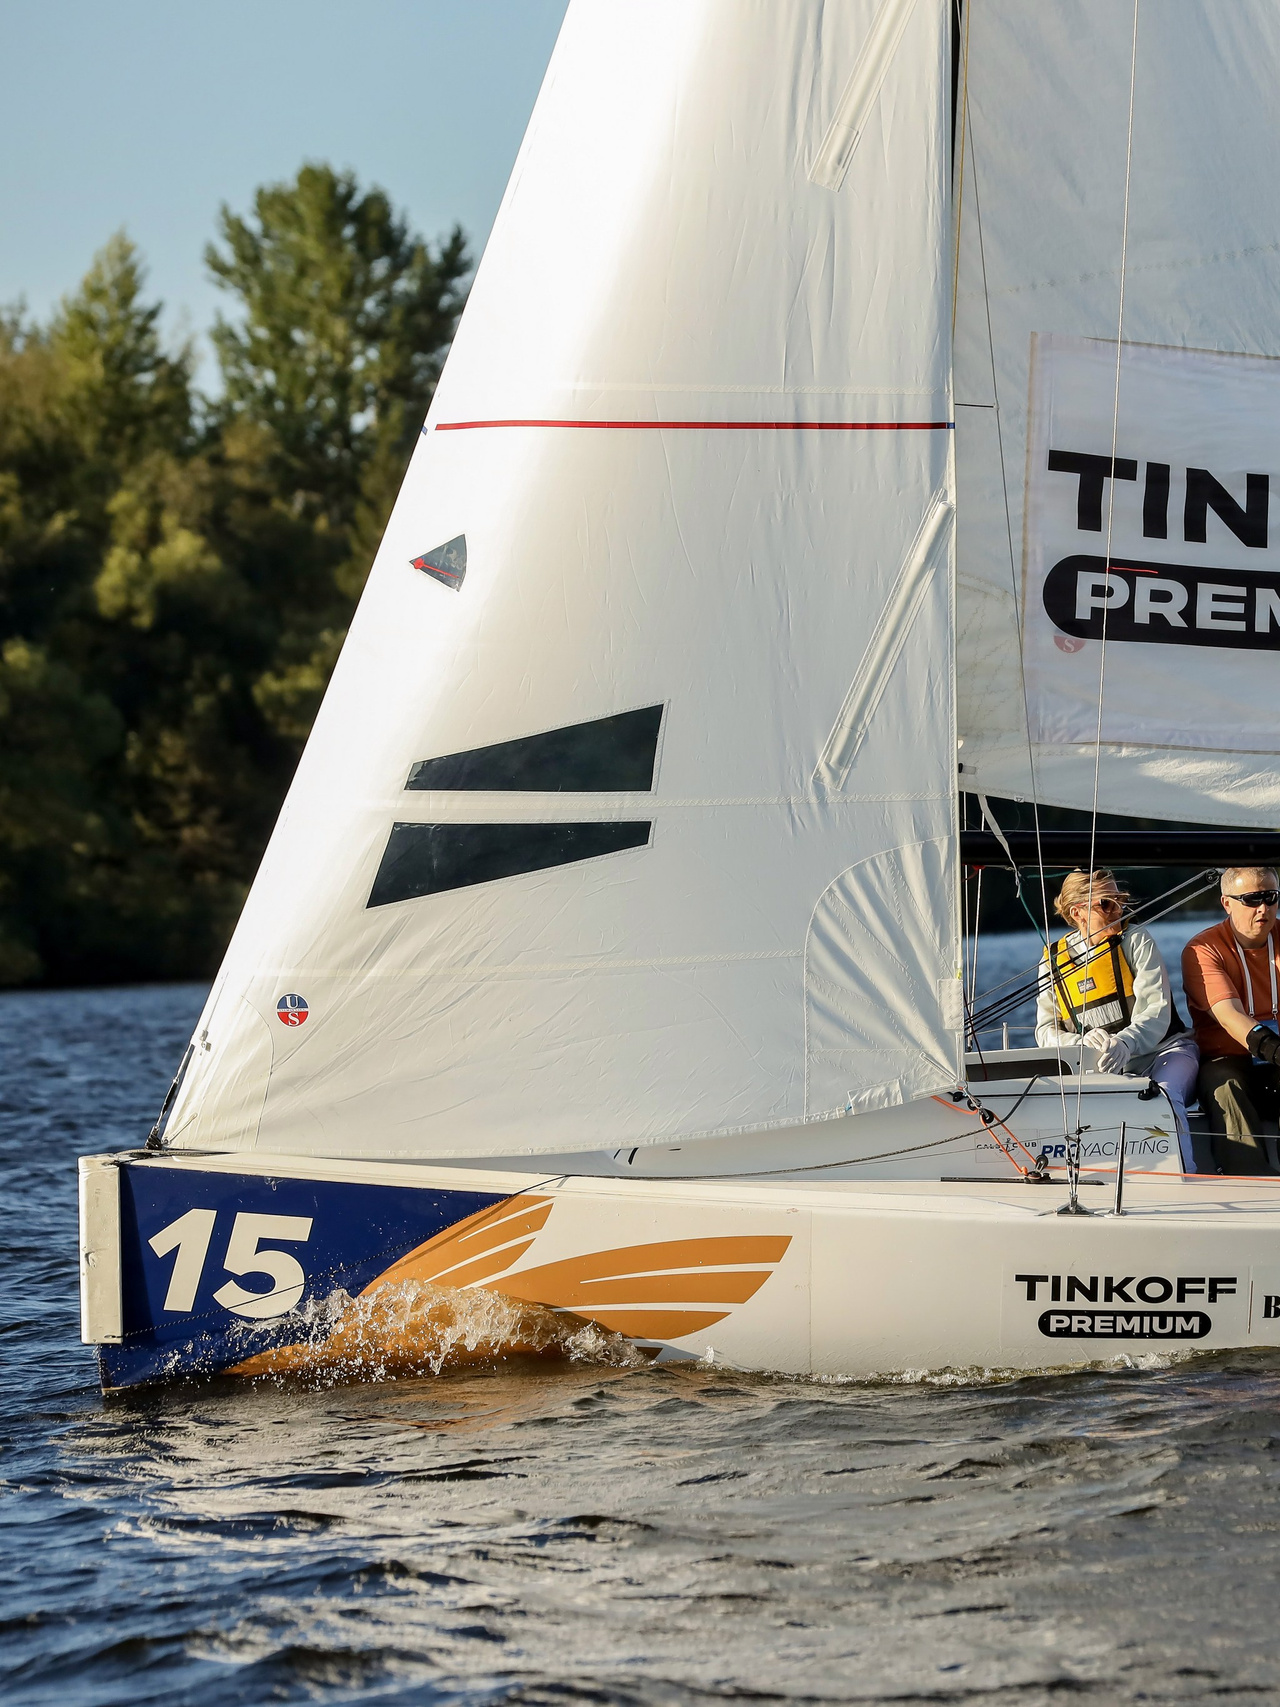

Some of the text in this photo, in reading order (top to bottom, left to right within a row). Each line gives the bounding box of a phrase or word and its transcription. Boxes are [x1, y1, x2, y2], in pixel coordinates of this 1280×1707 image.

[148, 1208, 313, 1319] 15
[1015, 1274, 1238, 1304] TINKOFF
[1050, 1315, 1200, 1335] PREMIUM
